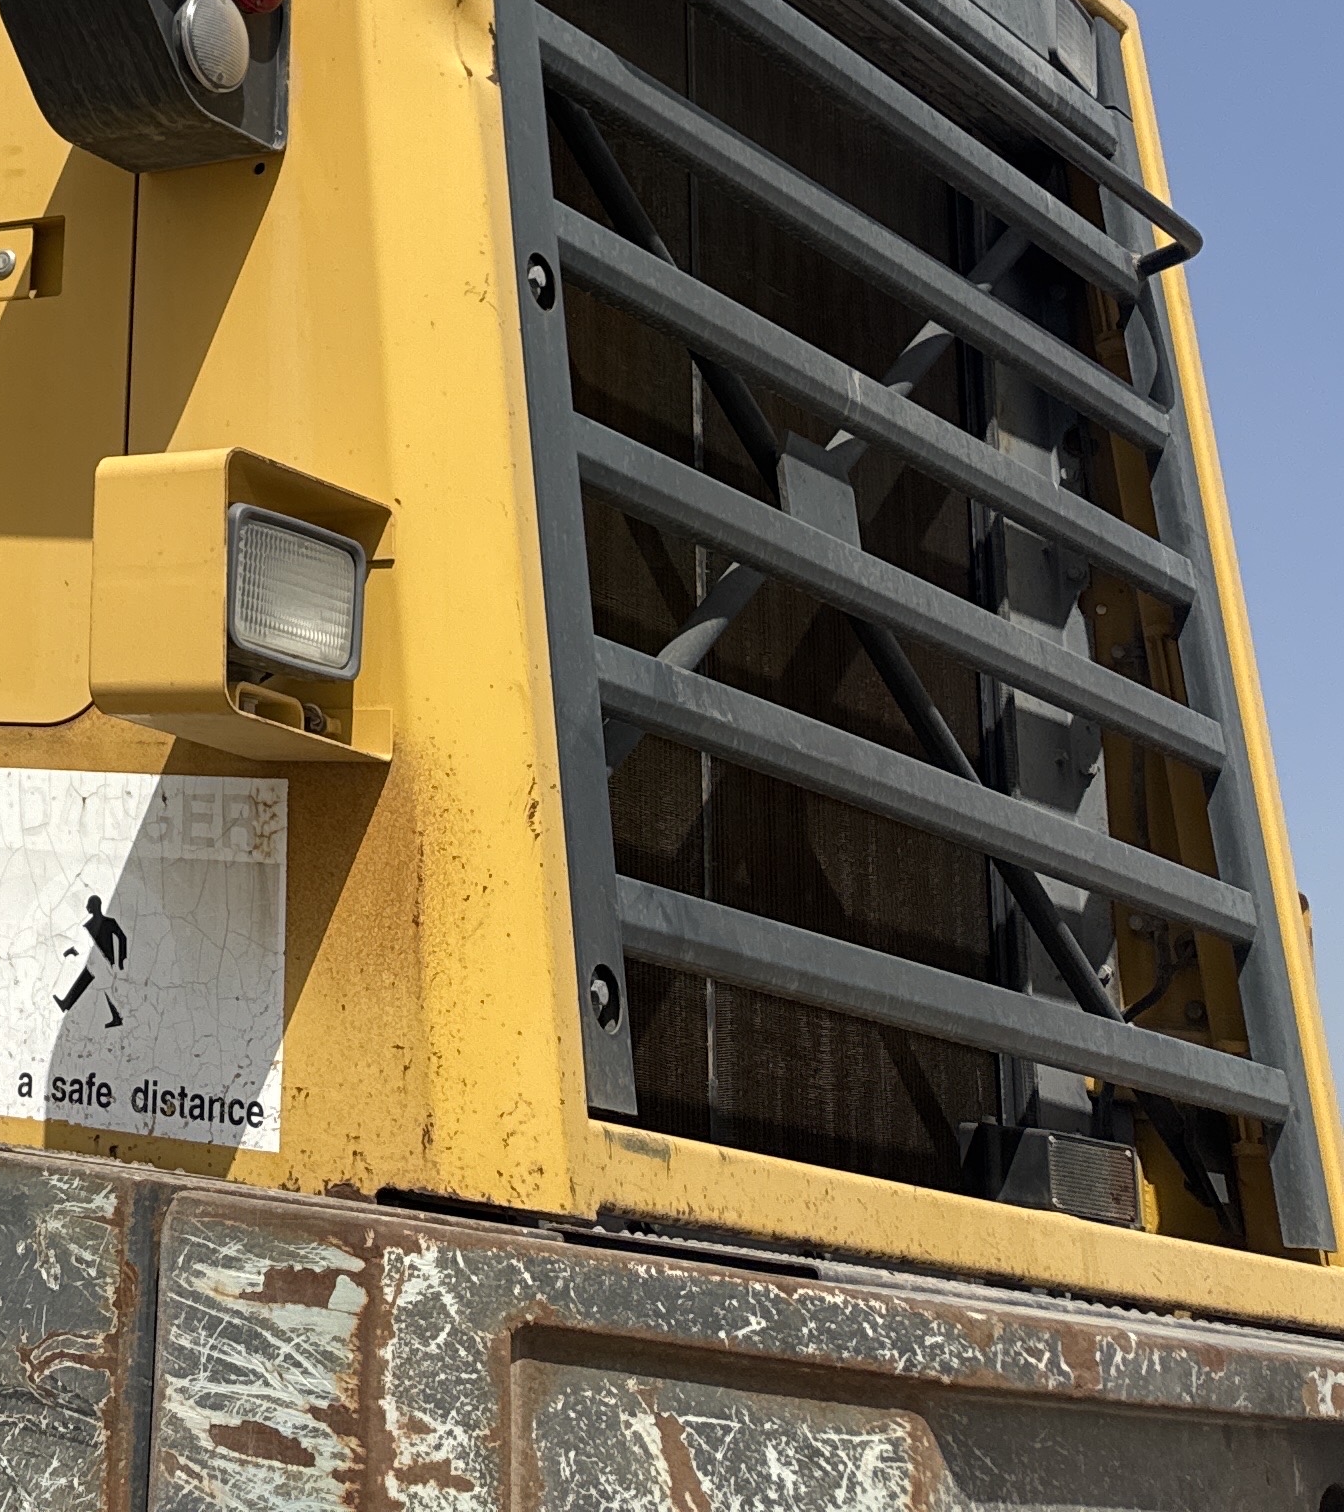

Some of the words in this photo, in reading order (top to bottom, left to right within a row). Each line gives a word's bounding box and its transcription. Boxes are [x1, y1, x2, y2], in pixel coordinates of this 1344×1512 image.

[17, 1072, 33, 1099] a
[51, 1072, 113, 1109] safe
[131, 1079, 264, 1128] distance
